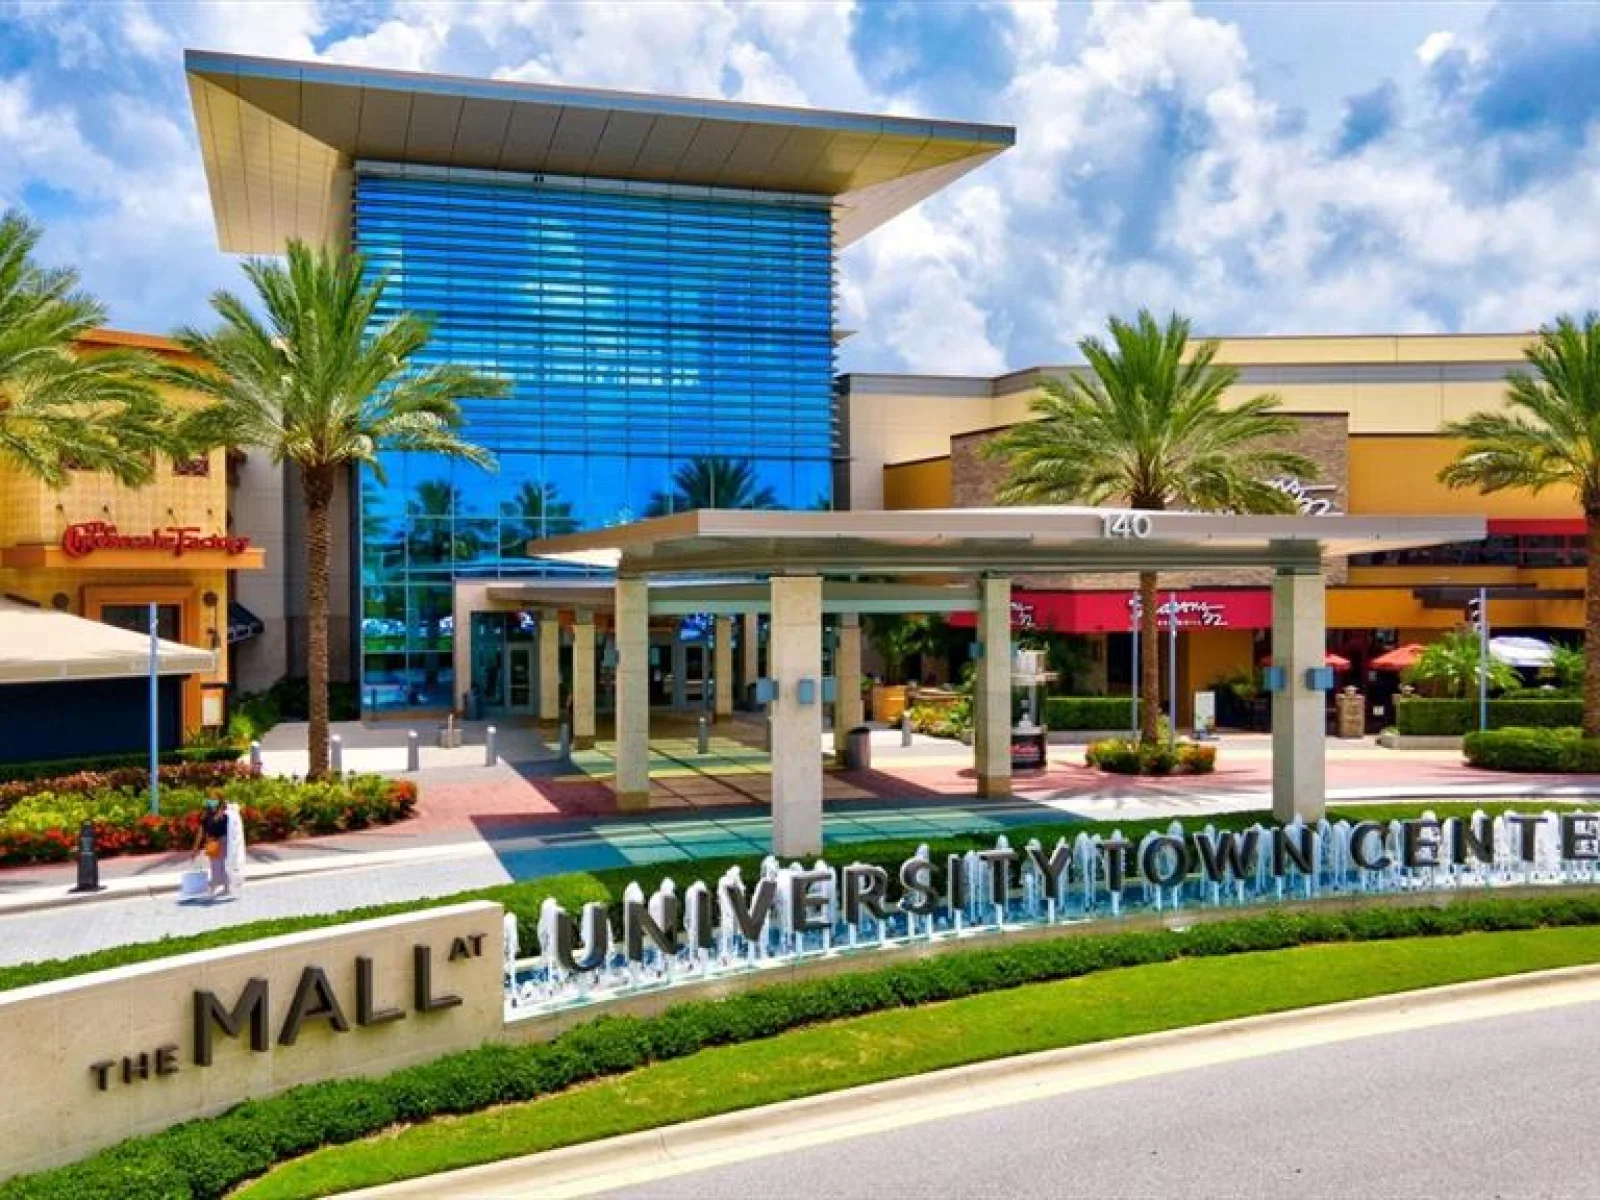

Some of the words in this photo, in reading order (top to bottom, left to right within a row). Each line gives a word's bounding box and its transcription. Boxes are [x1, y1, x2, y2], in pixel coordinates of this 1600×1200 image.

[165, 526, 252, 558] Factory
[1100, 513, 1153, 539] 140
[554, 844, 1072, 972] UNIVERSITY
[1096, 821, 1314, 892] TOWN
[89, 1043, 180, 1091] THE
[191, 943, 463, 1067] MALL
[447, 932, 487, 962] AT
